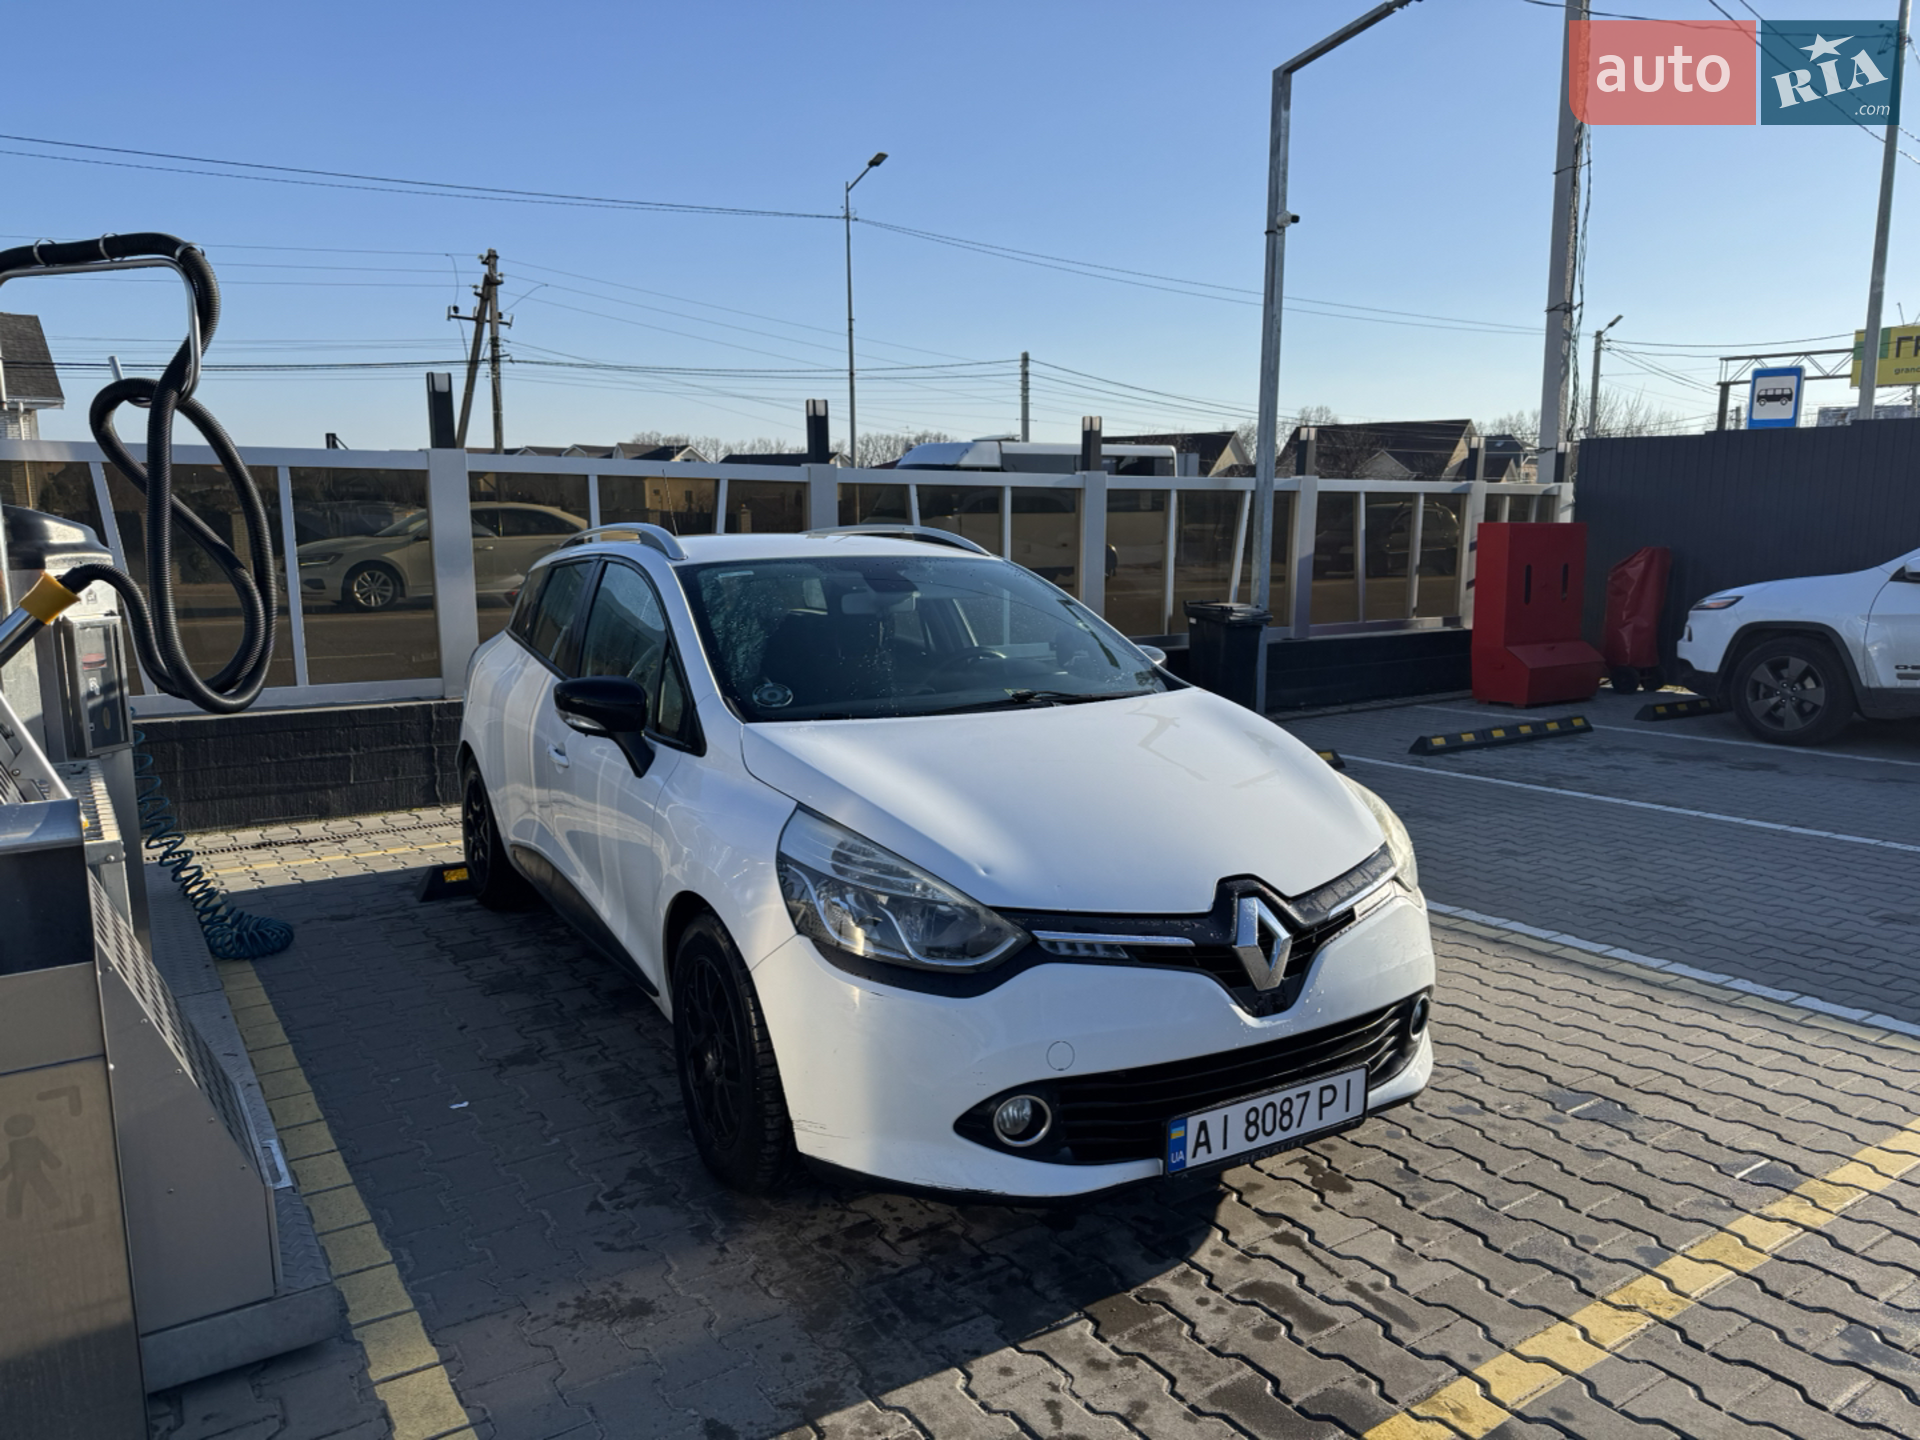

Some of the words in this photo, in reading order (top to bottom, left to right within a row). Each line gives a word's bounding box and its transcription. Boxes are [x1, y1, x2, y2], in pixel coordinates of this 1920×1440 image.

[1191, 1114, 1229, 1159] AI
[1244, 1091, 1310, 1143] 8087
[1318, 1078, 1351, 1121] PI
[1171, 1150, 1185, 1164] UA
